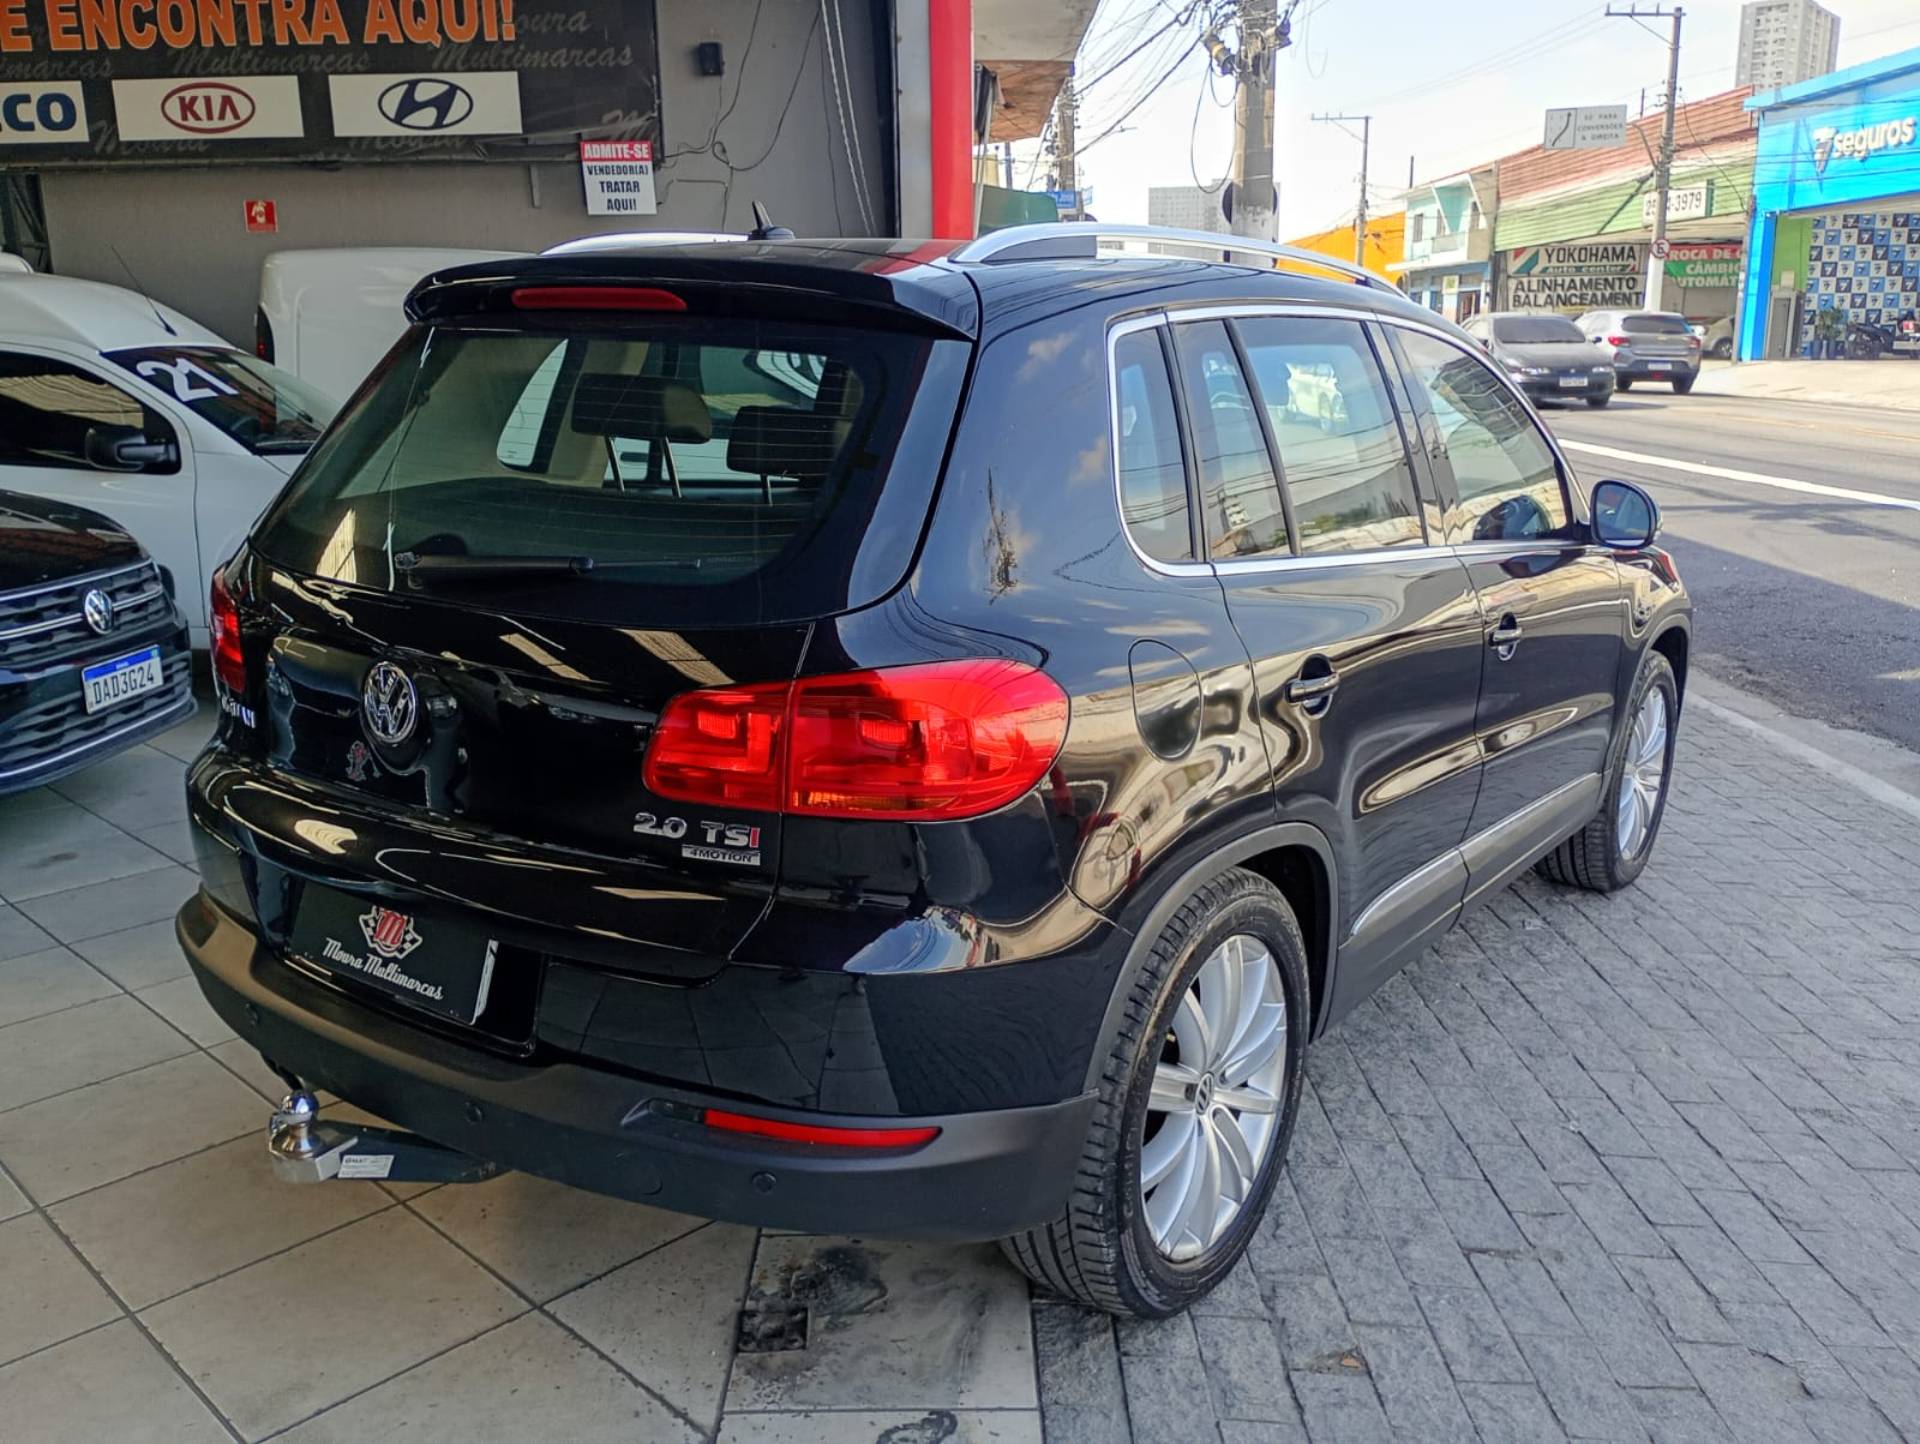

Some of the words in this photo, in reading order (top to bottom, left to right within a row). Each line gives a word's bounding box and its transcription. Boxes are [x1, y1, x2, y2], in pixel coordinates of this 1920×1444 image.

[46, 0, 350, 50] ENCONTRA
[363, 0, 516, 48] AQUI!
[0, 92, 77, 132] CO
[177, 94, 241, 122] KIA
[1831, 116, 1917, 159] seguros
[583, 143, 650, 159] ADMITE-SE
[586, 164, 649, 176] VENDEDOR(A)
[599, 180, 641, 193] TRATAR
[606, 198, 637, 212] AQUI!
[1545, 246, 1637, 264] YOKOHAMA
[1668, 249, 1709, 261] ROCA
[1514, 277, 1638, 293] ALINHAMENTO
[1512, 291, 1644, 308] BALANCEAMENT
[93, 662, 154, 704] DAD3G24
[700, 820, 760, 848] TSI
[689, 849, 752, 863] 4MOTION
[322, 937, 364, 972] Moura
[363, 953, 444, 1001] Multimarcas
